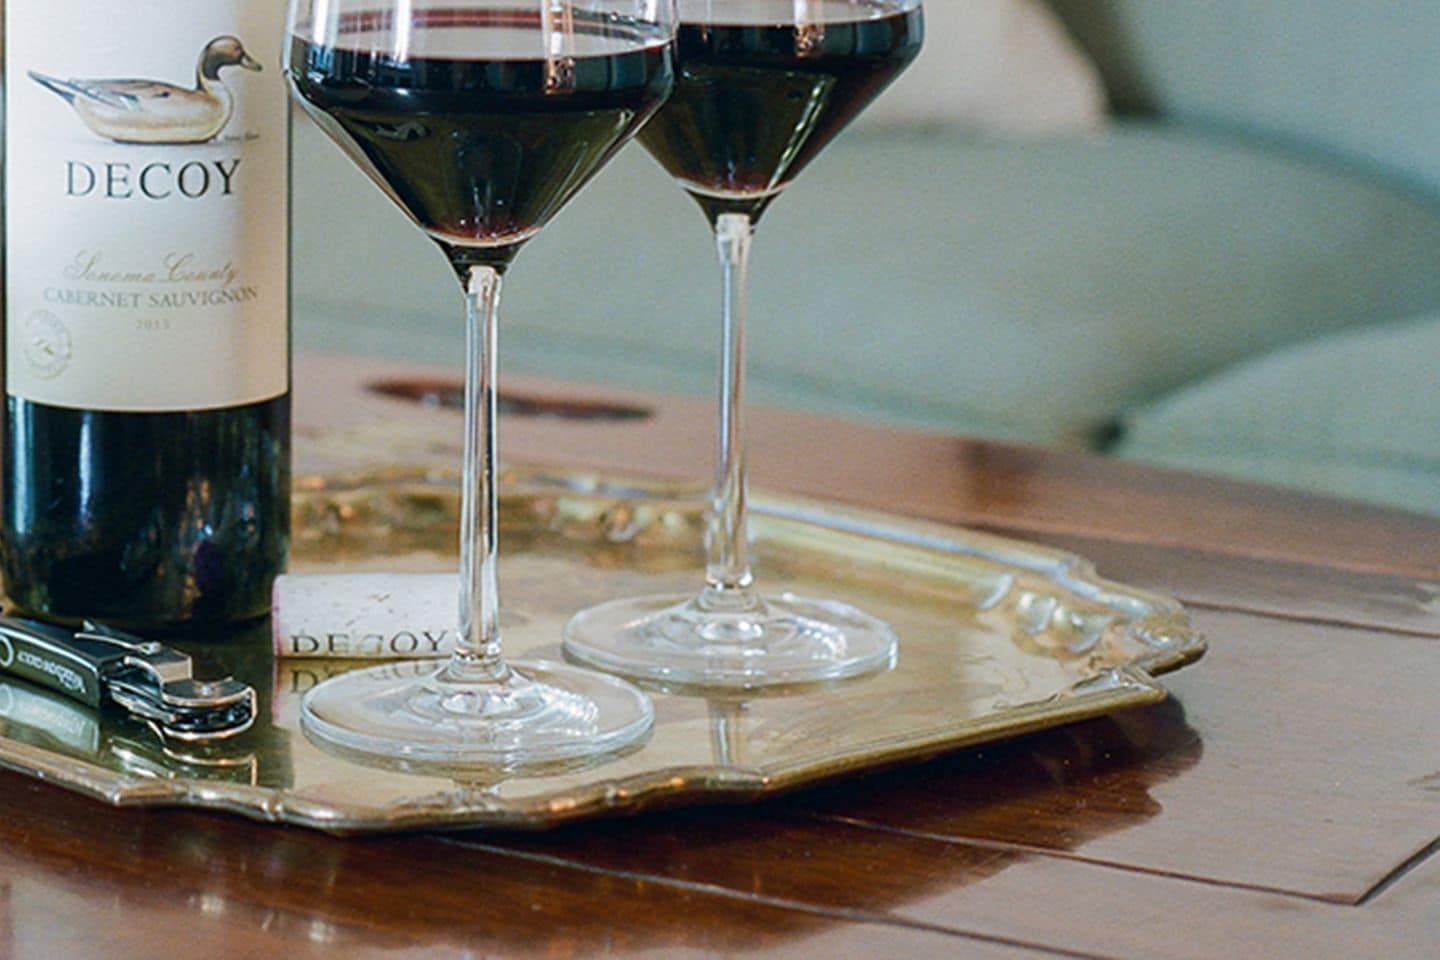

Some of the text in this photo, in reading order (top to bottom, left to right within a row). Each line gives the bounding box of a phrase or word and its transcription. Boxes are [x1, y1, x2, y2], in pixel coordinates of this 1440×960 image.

[66, 159, 241, 199] DECOY
[44, 285, 259, 309] CABERNET SAUVIGNON
